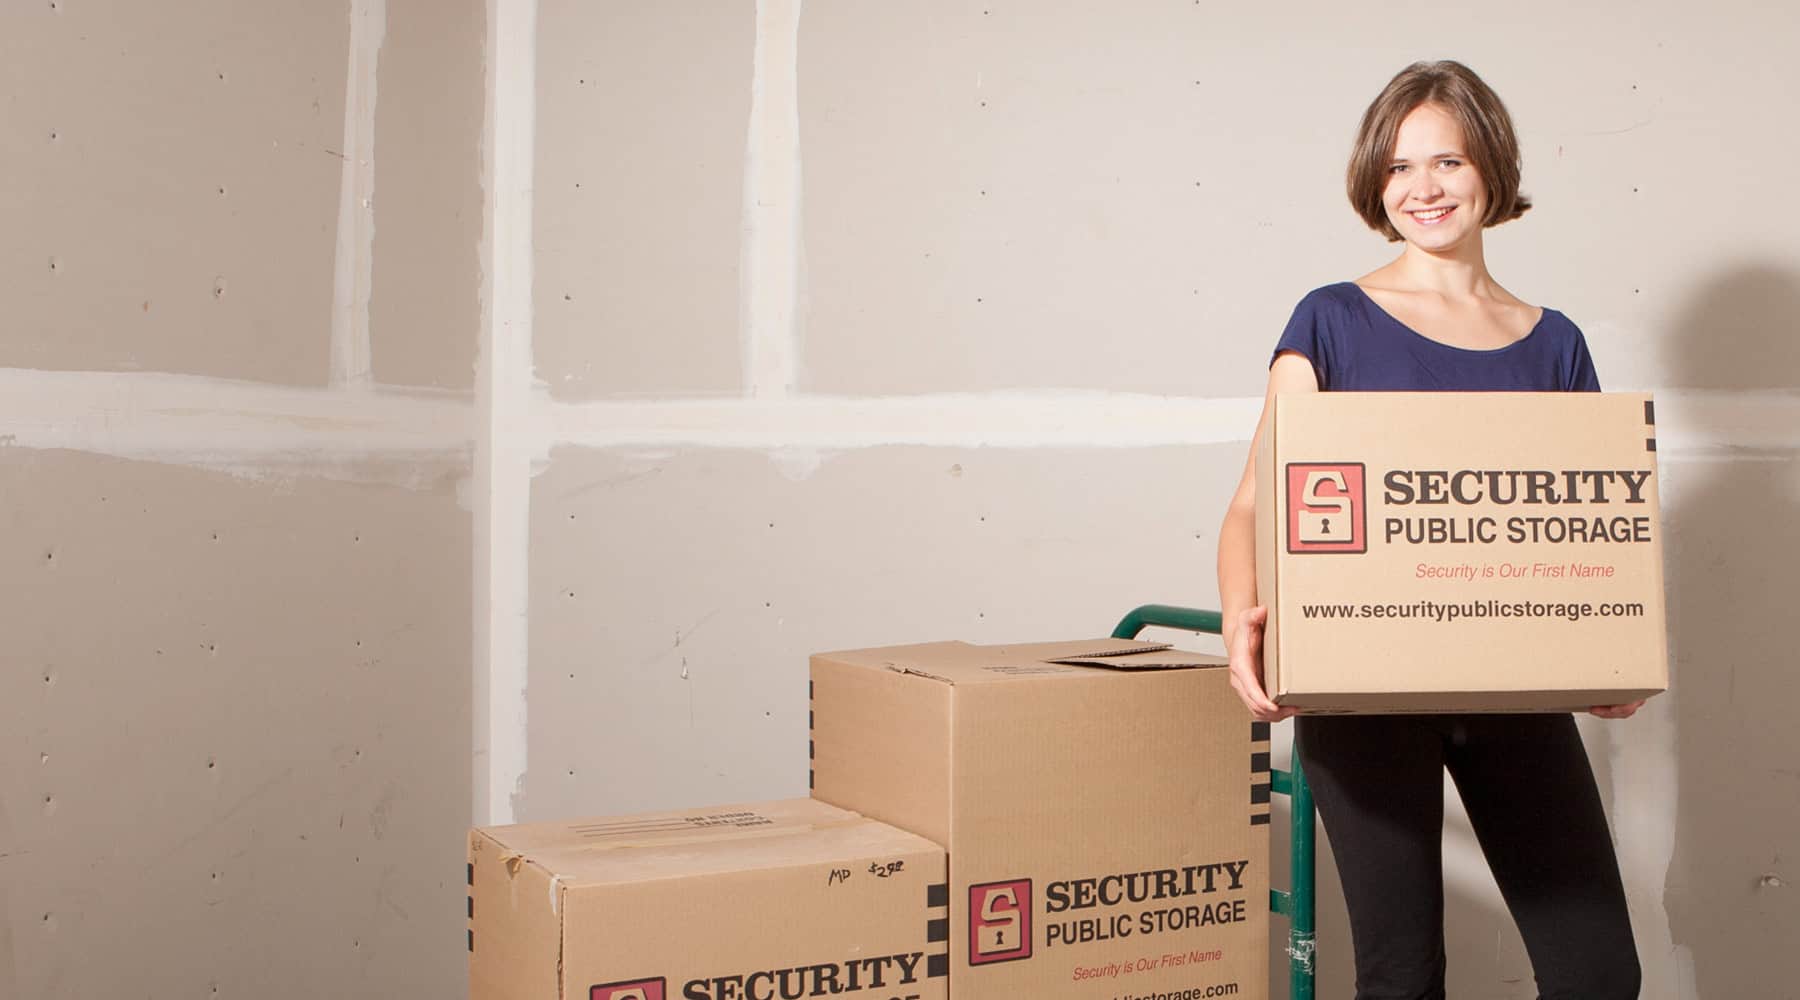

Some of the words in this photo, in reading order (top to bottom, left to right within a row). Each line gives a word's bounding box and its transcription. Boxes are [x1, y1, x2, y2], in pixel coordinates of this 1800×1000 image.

[1384, 470, 1652, 506] SECURITY
[1385, 517, 1497, 545] PUBLIC
[1507, 516, 1652, 544] STORAGE
[1416, 562, 1477, 581] Security
[1482, 563, 1495, 578] is
[1498, 562, 1527, 578] Our
[1532, 562, 1566, 577] First
[1570, 562, 1615, 577] Name
[1302, 599, 1644, 623] www.securitypublicstorage.com
[1046, 860, 1249, 913] SECURITY
[1047, 914, 1132, 947] PUBLIC
[1139, 900, 1246, 934] STORAGE
[682, 952, 924, 1000] SECURITY
[1072, 963, 1121, 981] Security
[1123, 960, 1133, 974] is
[1136, 958, 1159, 972] Our
[1161, 954, 1186, 968] First
[1188, 950, 1222, 964] Name
